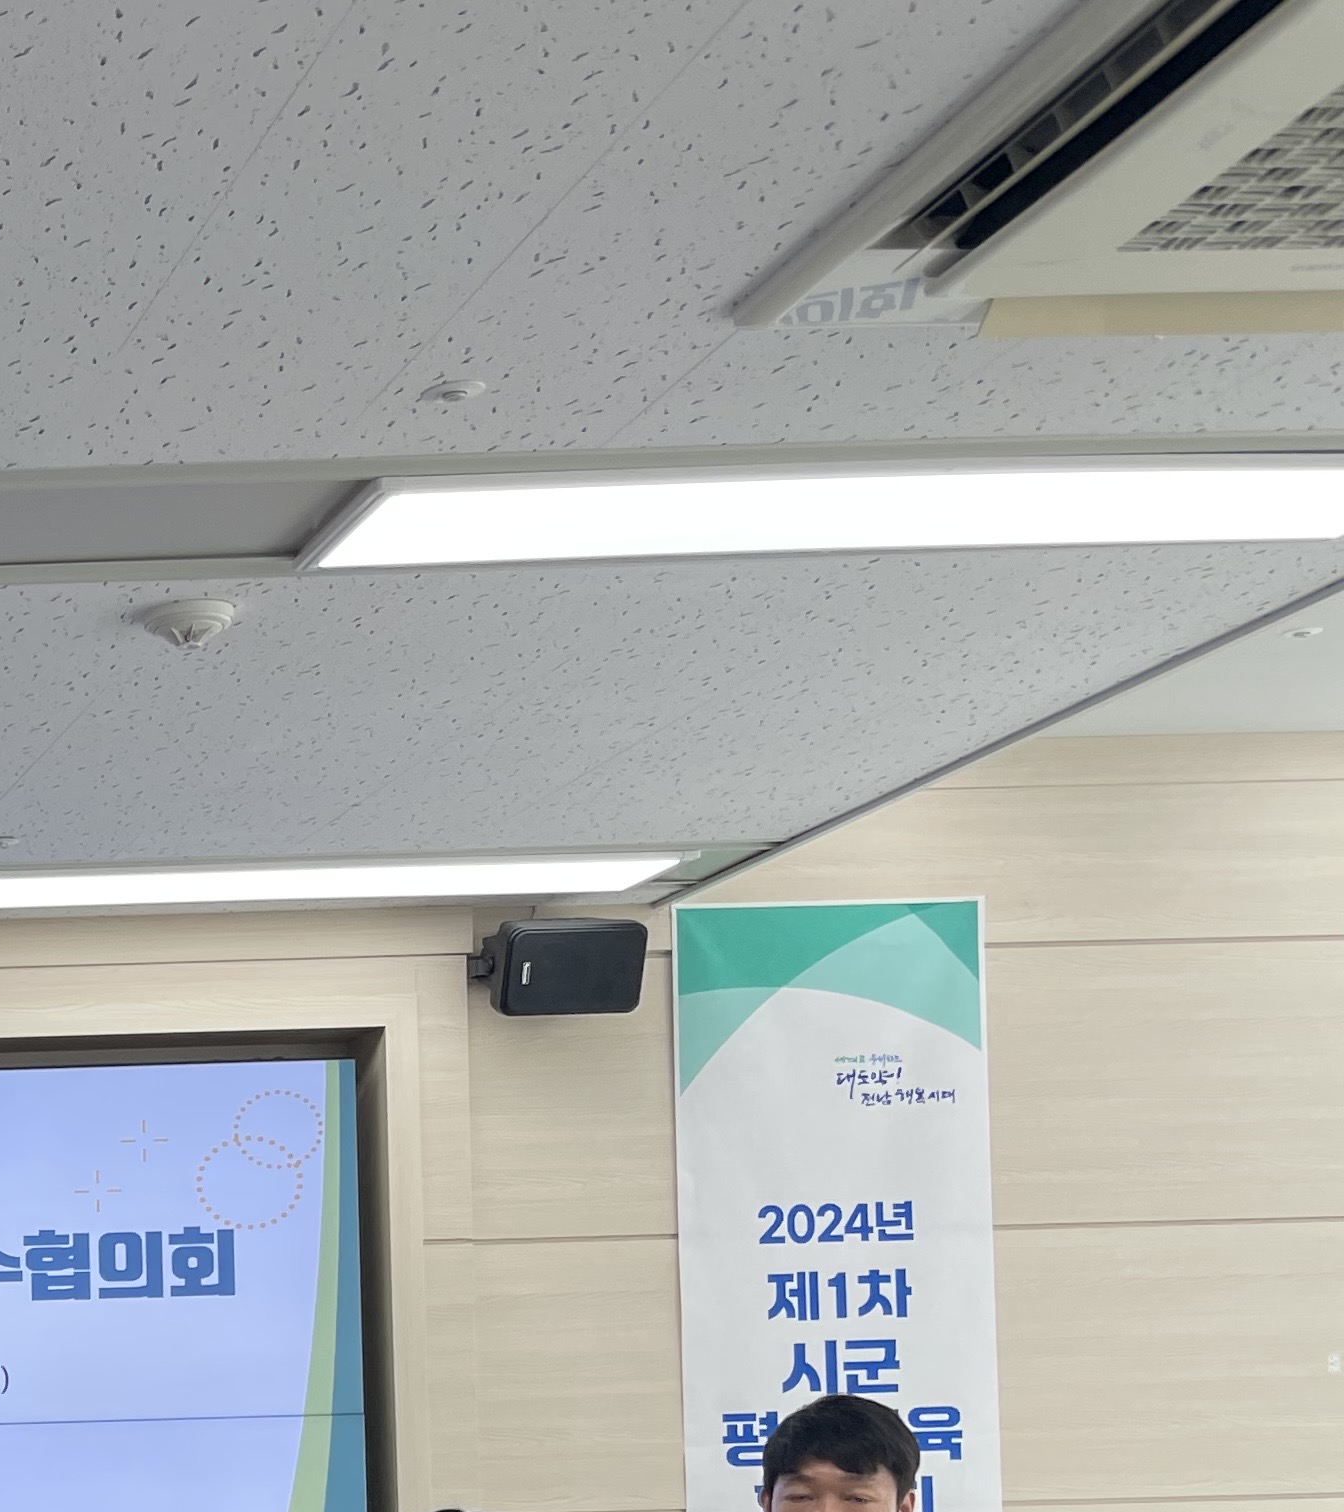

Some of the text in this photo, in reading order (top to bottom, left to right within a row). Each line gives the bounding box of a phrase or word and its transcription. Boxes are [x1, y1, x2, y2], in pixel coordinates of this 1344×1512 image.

[758, 1201, 914, 1244] 2024년
[768, 1269, 912, 1321] 제1차
[783, 1339, 900, 1394] 시군
